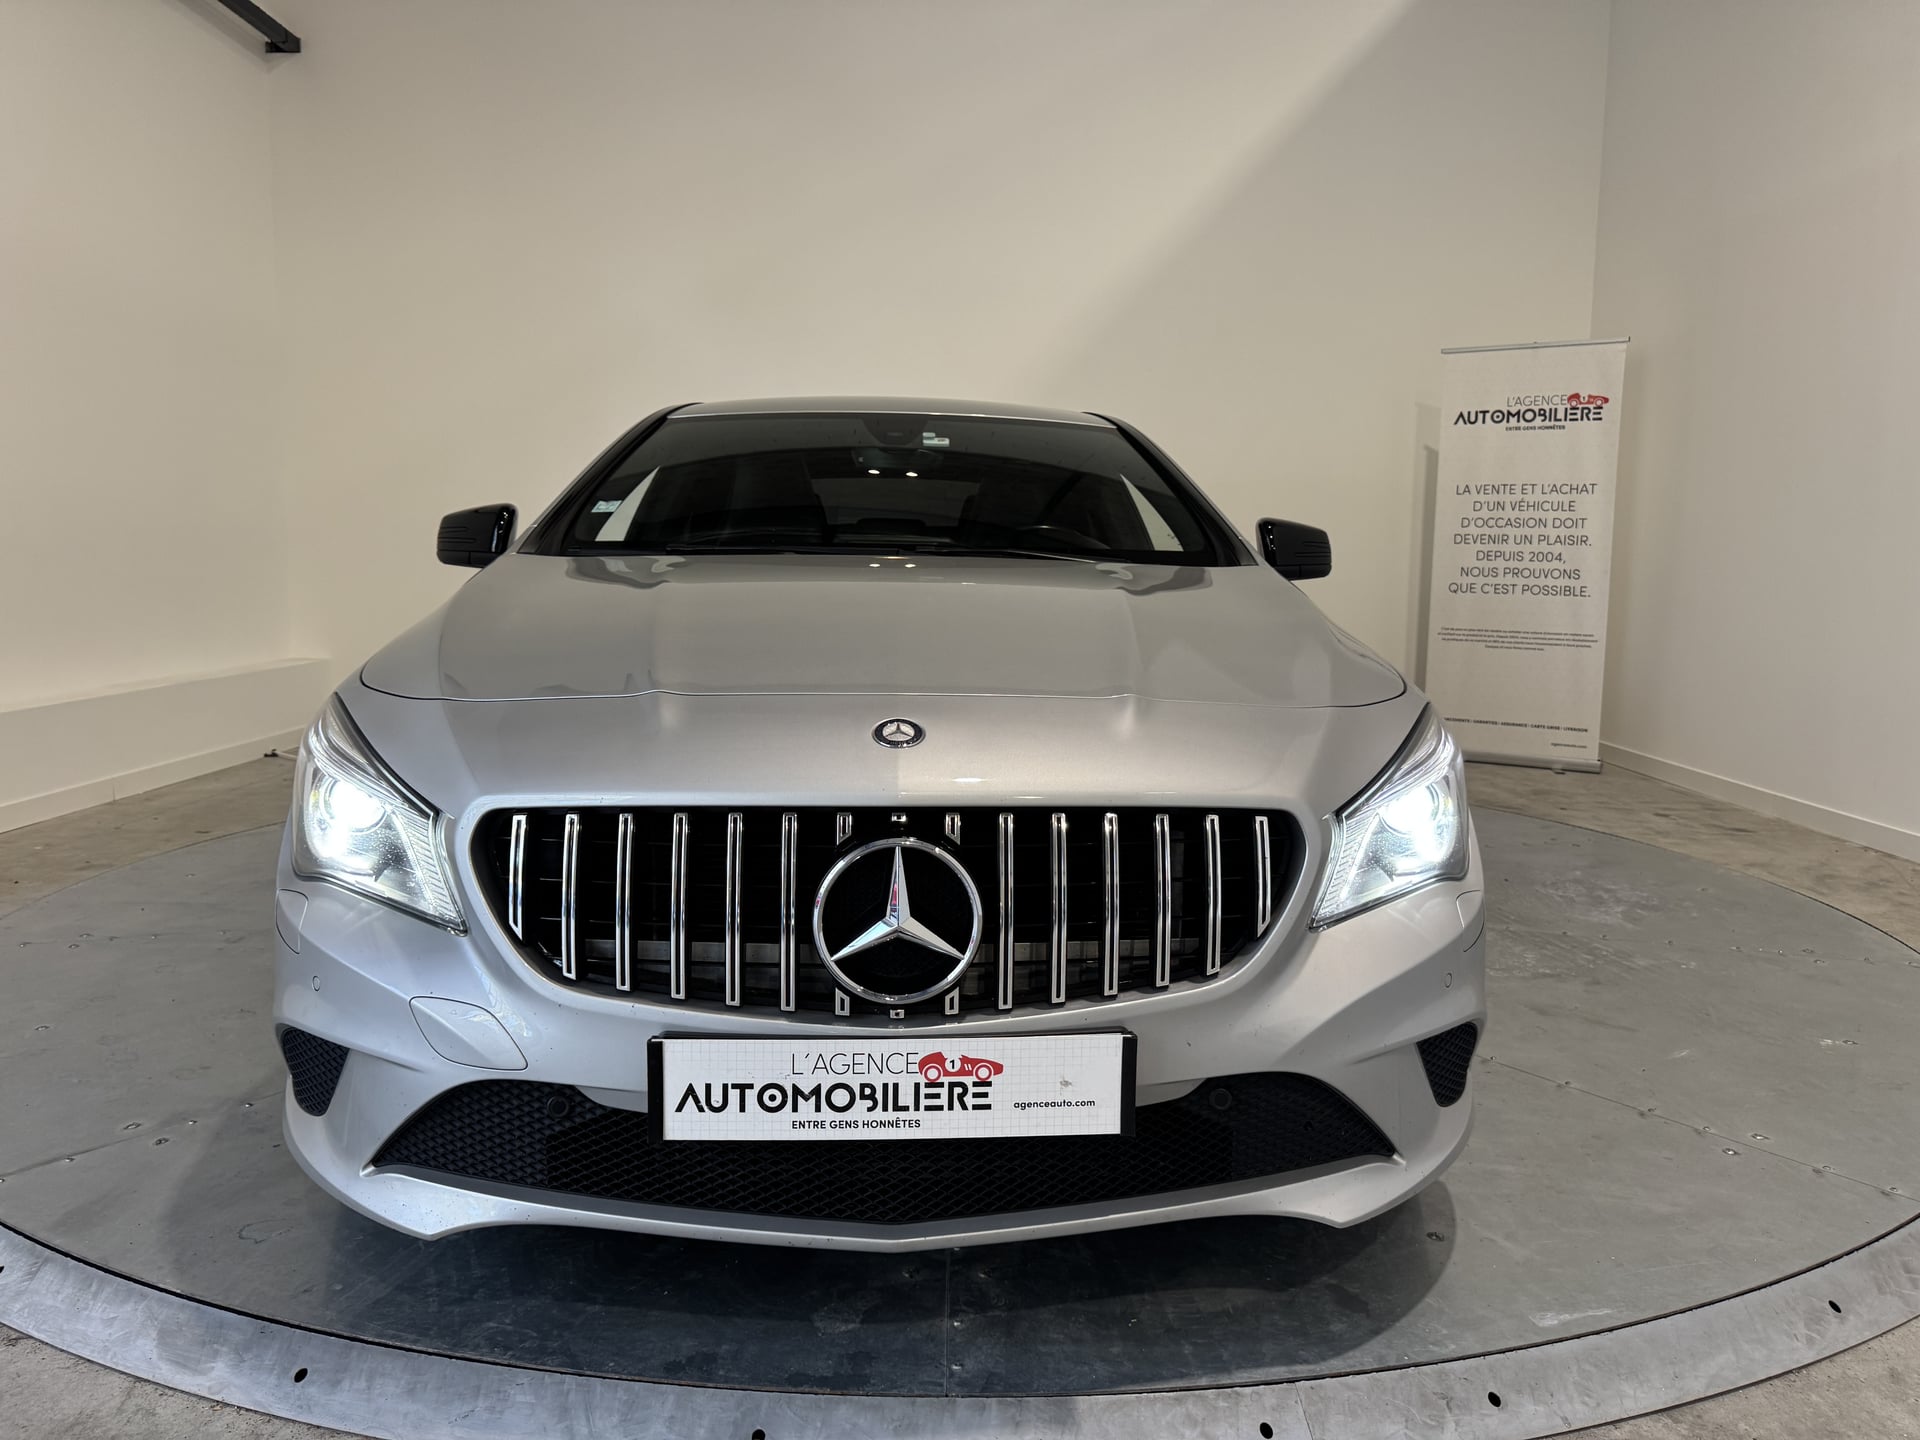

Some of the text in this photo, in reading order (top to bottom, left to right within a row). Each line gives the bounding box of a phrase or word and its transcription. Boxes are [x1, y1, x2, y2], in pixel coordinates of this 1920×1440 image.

[1507, 395, 1568, 407] L'AGENCE
[1455, 483, 1598, 496] LA VENTE ET L'ACHAT
[1472, 498, 1576, 512] D'UN VÉHICULE
[1460, 517, 1588, 529] D'OCCASION DOIT
[1453, 533, 1592, 546] DEVENIR UN PLAISIR.
[1476, 550, 1566, 564] DEPUIS 2004,
[1460, 567, 1581, 580] NOUS PROUVONS
[1448, 582, 1592, 598] QUE C'EST POSSIBLE.
[791, 1052, 918, 1076] L'AGENCE
[949, 1059, 956, 1070] 1
[1013, 1098, 1096, 1111] agenceauto.com
[791, 1116, 921, 1130] ENTRE GENS HONNÊTES
